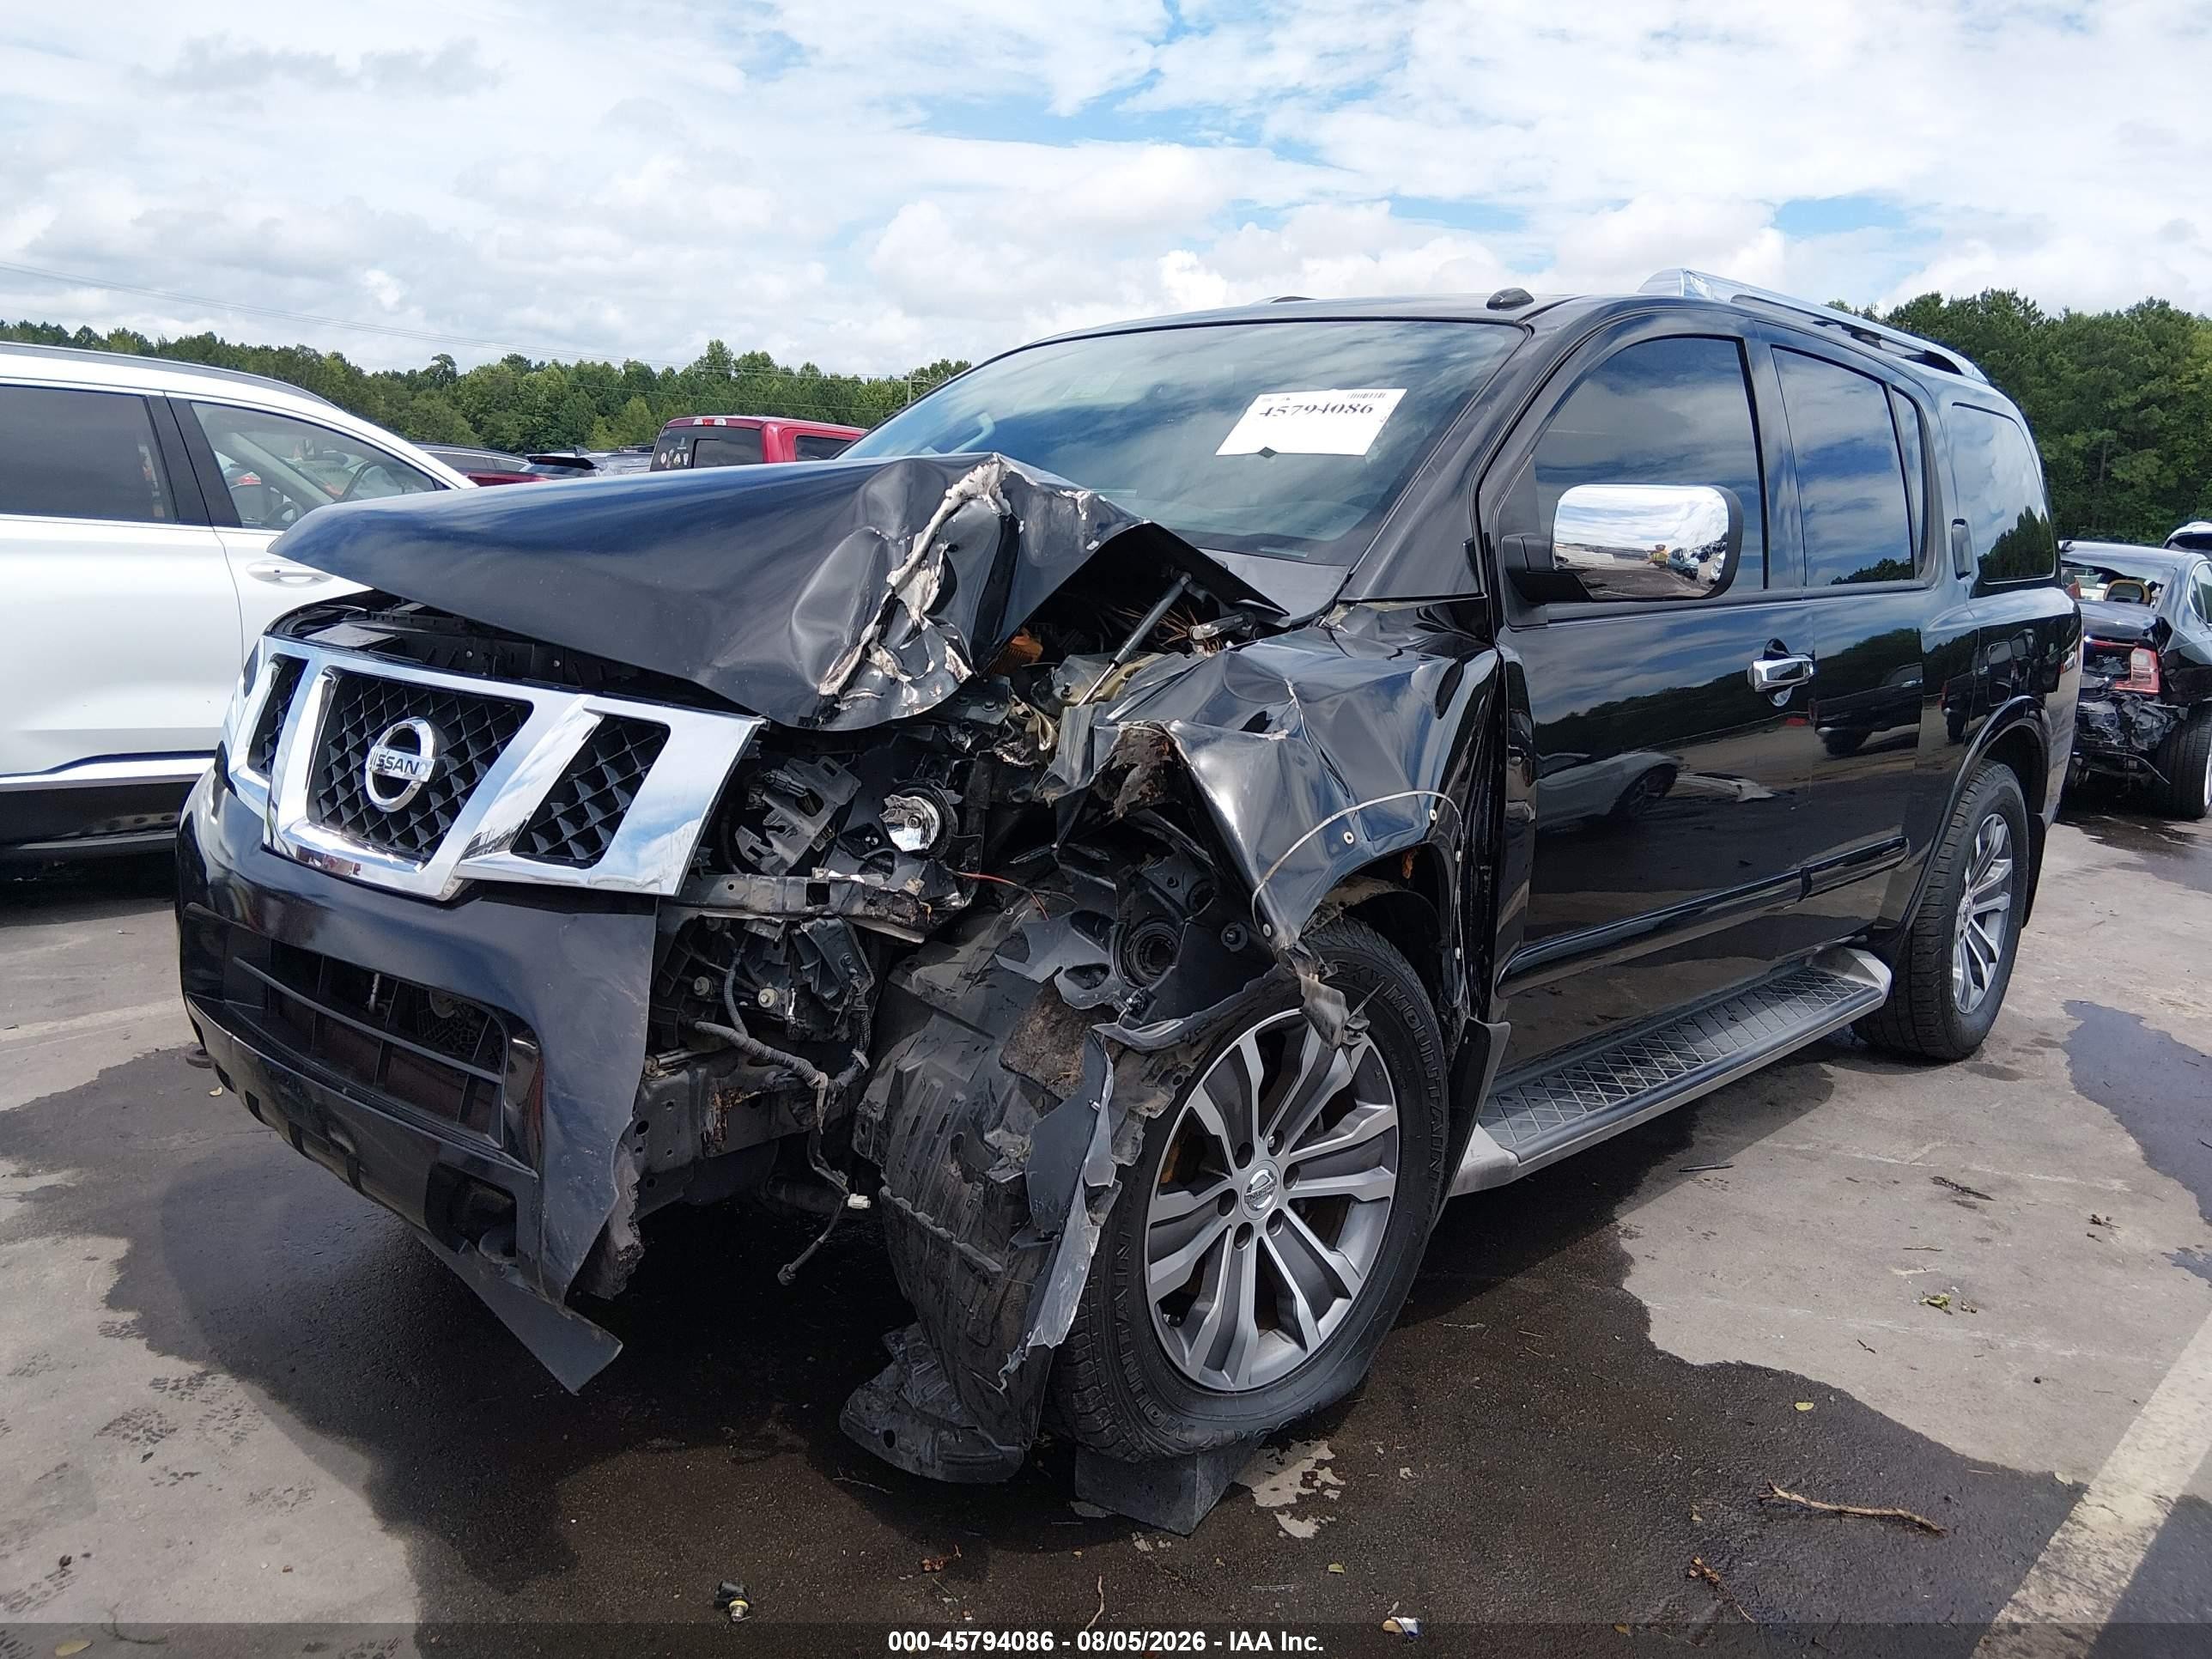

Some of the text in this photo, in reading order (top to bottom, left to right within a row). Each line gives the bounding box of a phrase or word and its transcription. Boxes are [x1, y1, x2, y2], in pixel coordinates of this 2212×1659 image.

[1259, 403, 1374, 416] 45794086
[1383, 982, 1446, 1175] MOUNTAIN
[1114, 1231, 1196, 1443] MOUNTAIN
